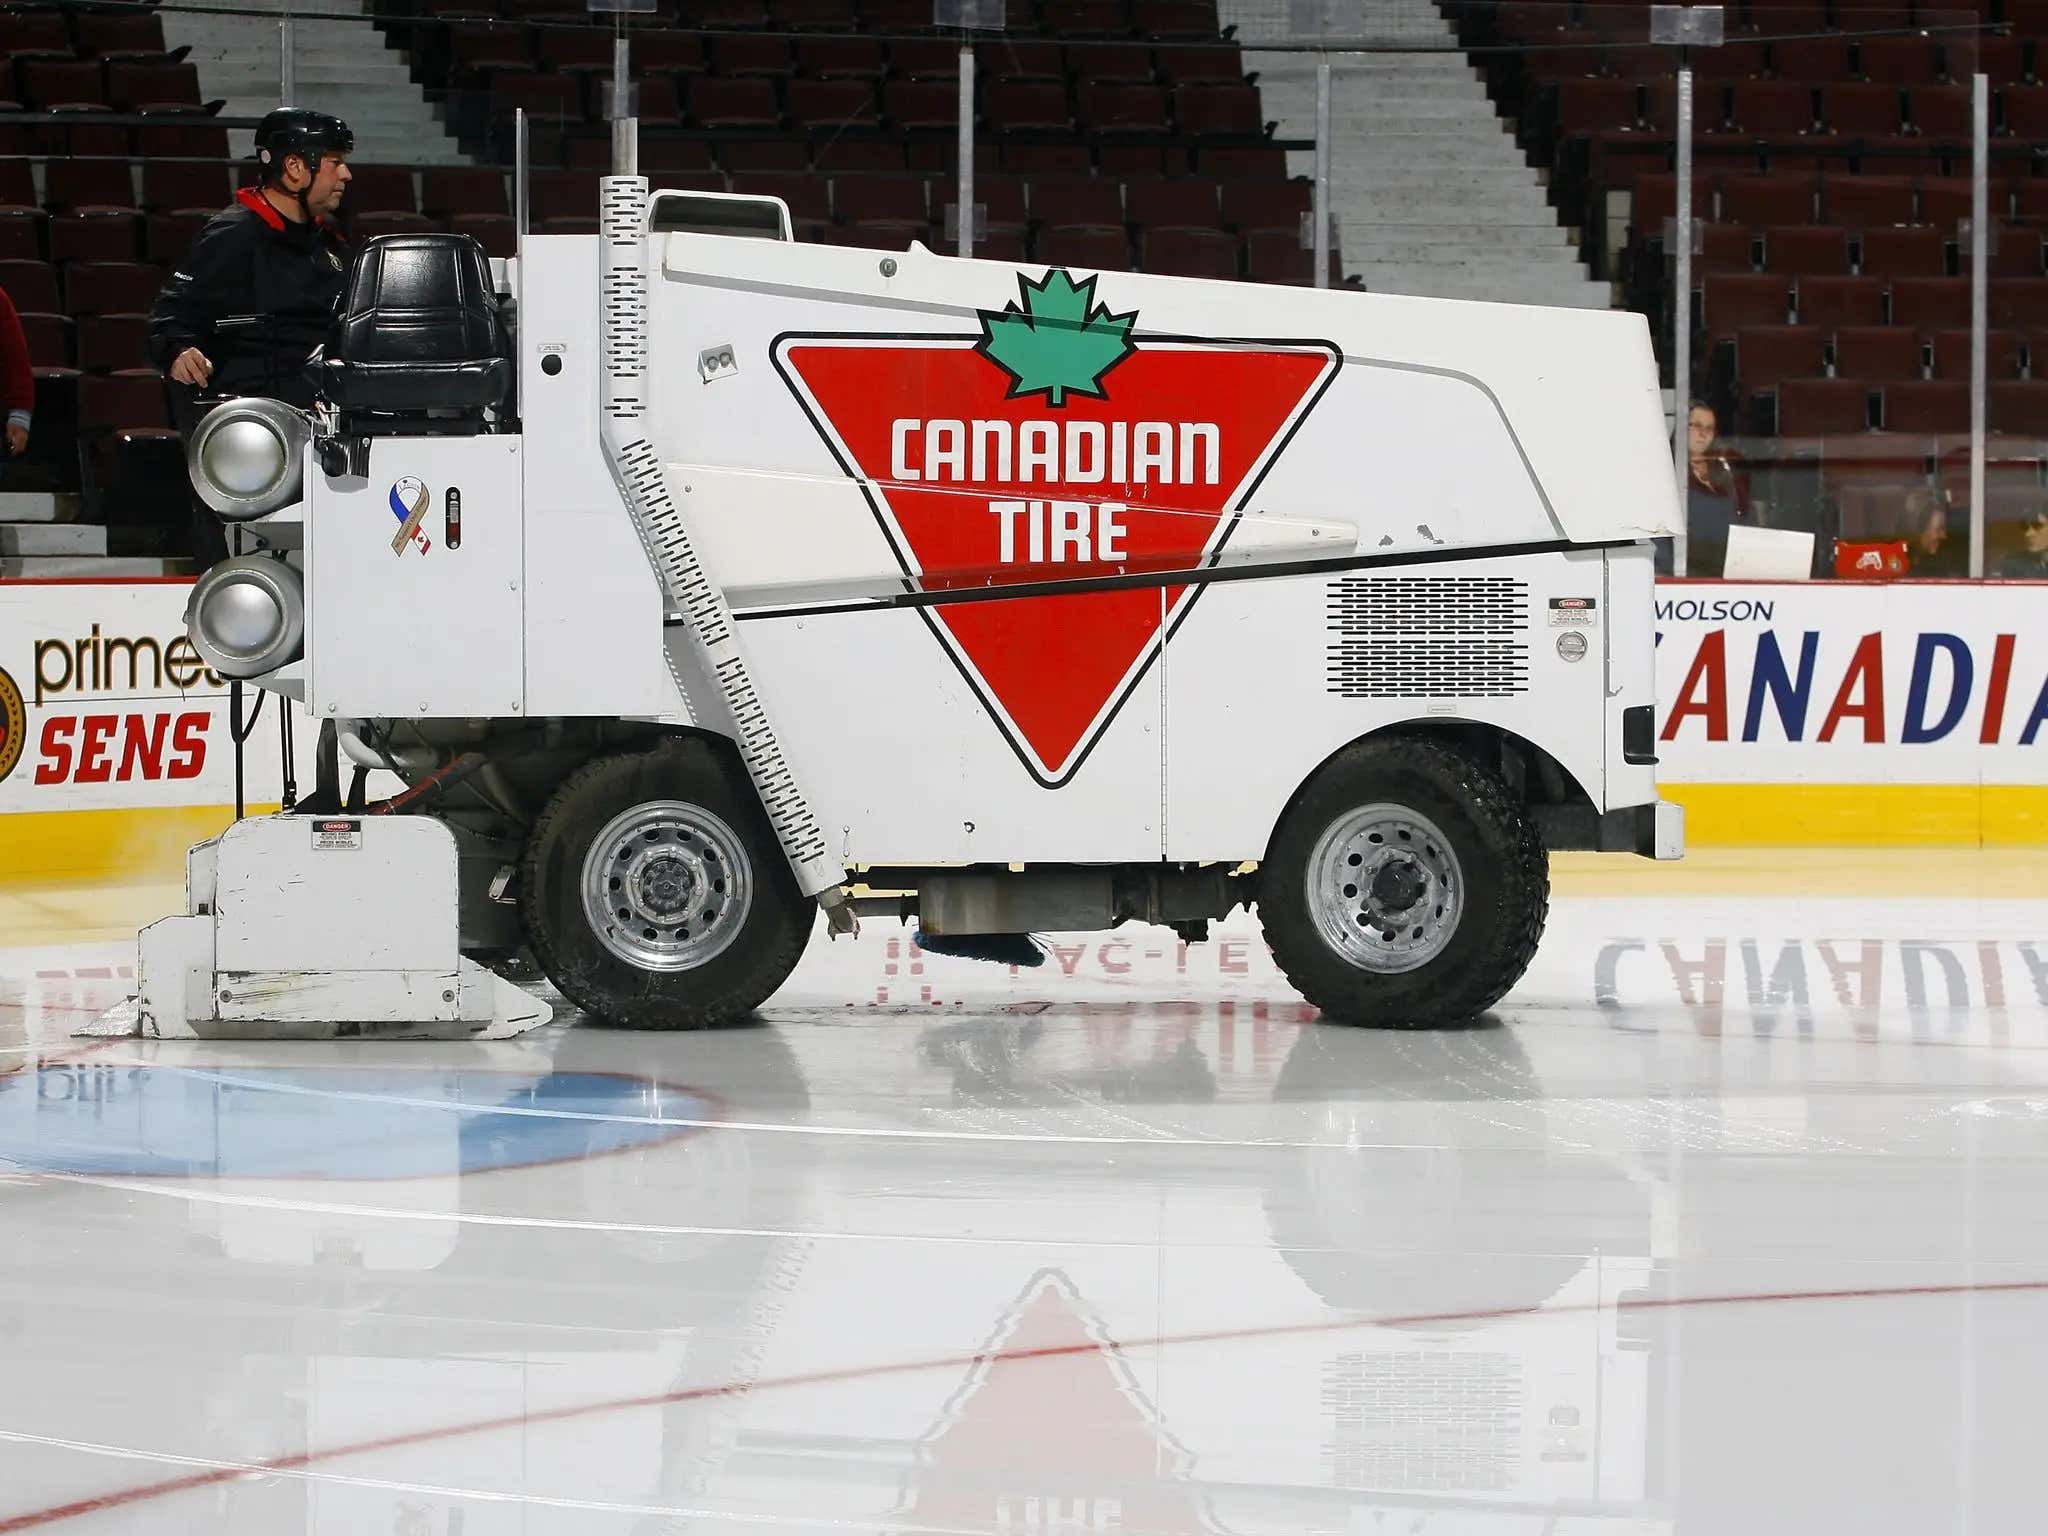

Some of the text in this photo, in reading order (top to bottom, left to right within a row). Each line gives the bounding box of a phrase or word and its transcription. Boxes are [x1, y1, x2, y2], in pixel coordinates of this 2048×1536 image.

[891, 418, 1220, 485] CANADIAN
[988, 501, 1128, 563] TIRE
[1655, 628, 2048, 745] ANADI
[34, 711, 212, 785] SENS
